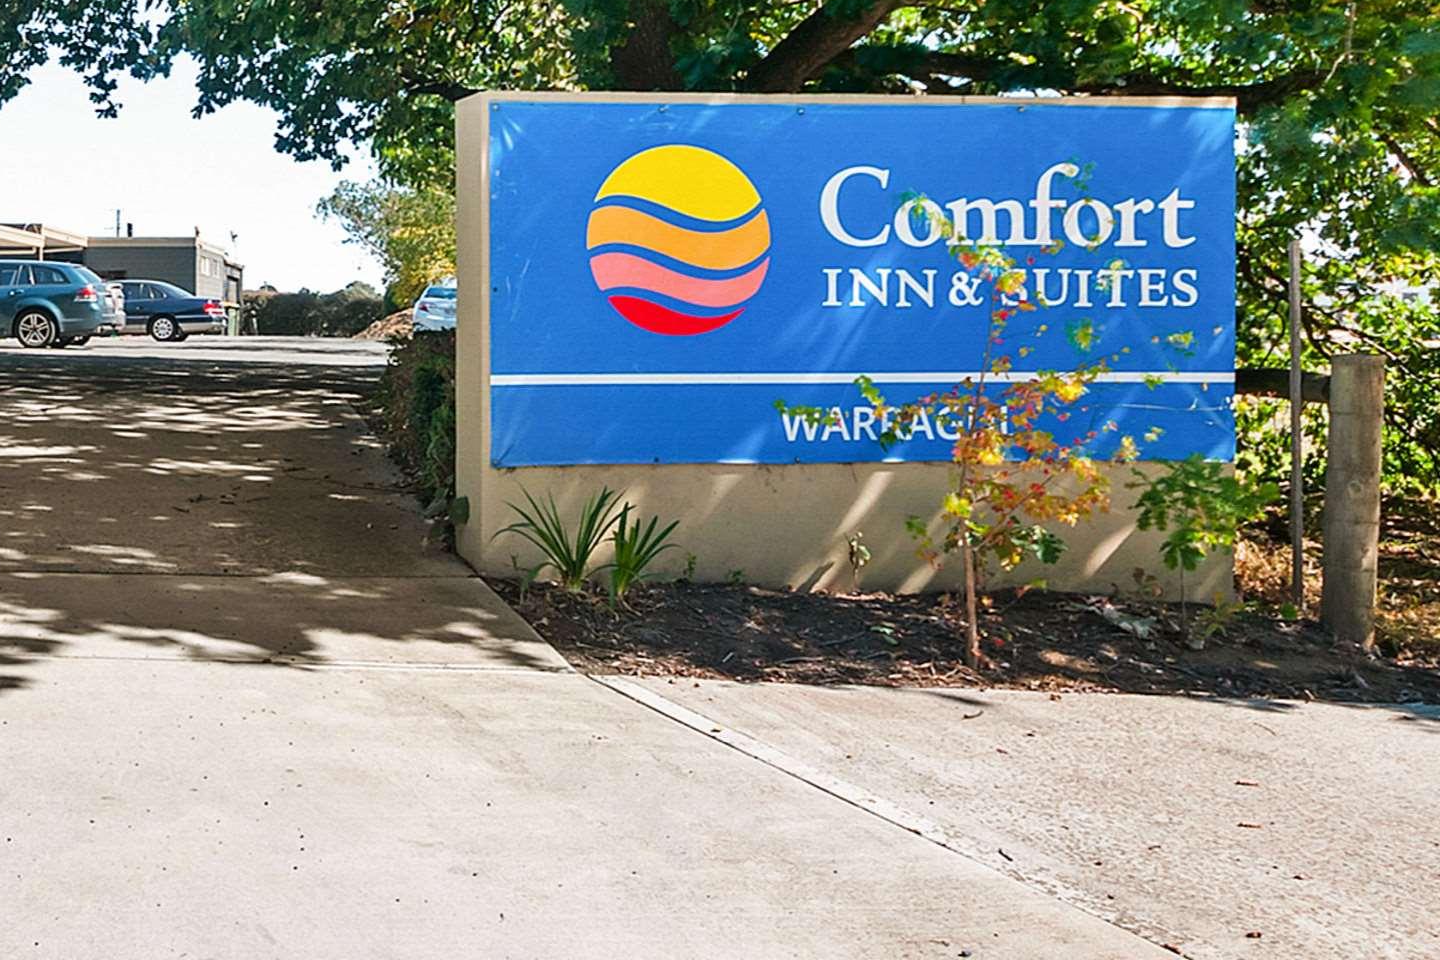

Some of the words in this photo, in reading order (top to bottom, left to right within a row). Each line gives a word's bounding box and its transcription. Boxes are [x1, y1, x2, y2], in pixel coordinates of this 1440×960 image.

[820, 163, 1196, 248] Comfort
[822, 268, 937, 307] INN
[948, 270, 984, 307] &
[998, 268, 1199, 308] SUITES
